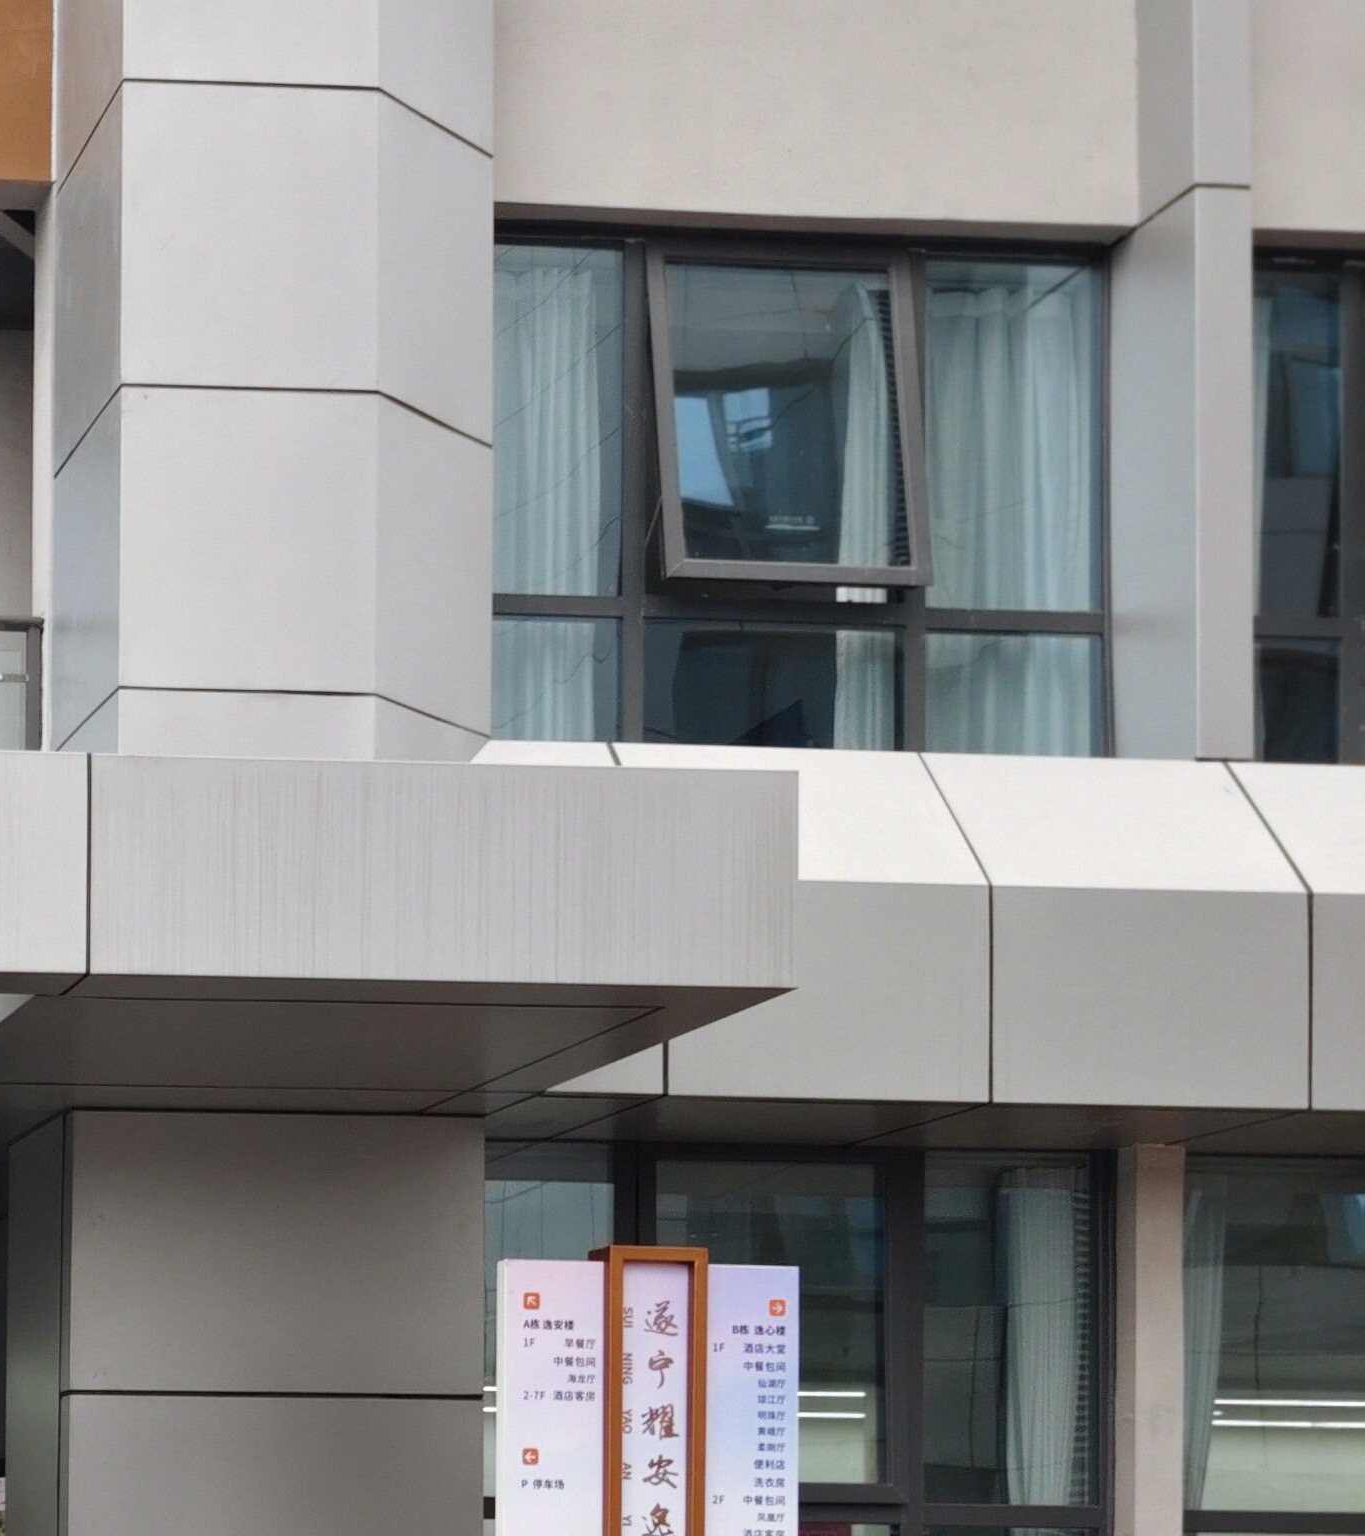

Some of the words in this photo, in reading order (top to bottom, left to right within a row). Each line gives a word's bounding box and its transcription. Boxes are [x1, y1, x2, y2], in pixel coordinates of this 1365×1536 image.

[622, 1306, 634, 1329] SUI
[542, 1319, 575, 1330] 逸安楼
[732, 1325, 749, 1335] B栋
[754, 1325, 786, 1336] 逸心楼
[524, 1338, 535, 1348] 1F
[564, 1339, 596, 1350] 早餐厅
[713, 1342, 725, 1353] 1F
[744, 1343, 786, 1354] 酒店大堂
[553, 1356, 597, 1368] 中餐包间
[743, 1361, 786, 1373] 中餐包间
[622, 1352, 633, 1385] NING
[523, 1390, 546, 1401] 2-7F
[553, 1391, 596, 1402] 酒店客房
[622, 1408, 633, 1435] YAO
[754, 1459, 786, 1470] 便利店
[622, 1462, 633, 1480] AN
[533, 1479, 565, 1490] 停车场
[754, 1477, 785, 1488] 洗衣房
[712, 1495, 725, 1505] 2F
[743, 1495, 786, 1506] 中餐包间
[622, 1514, 632, 1527] YI
